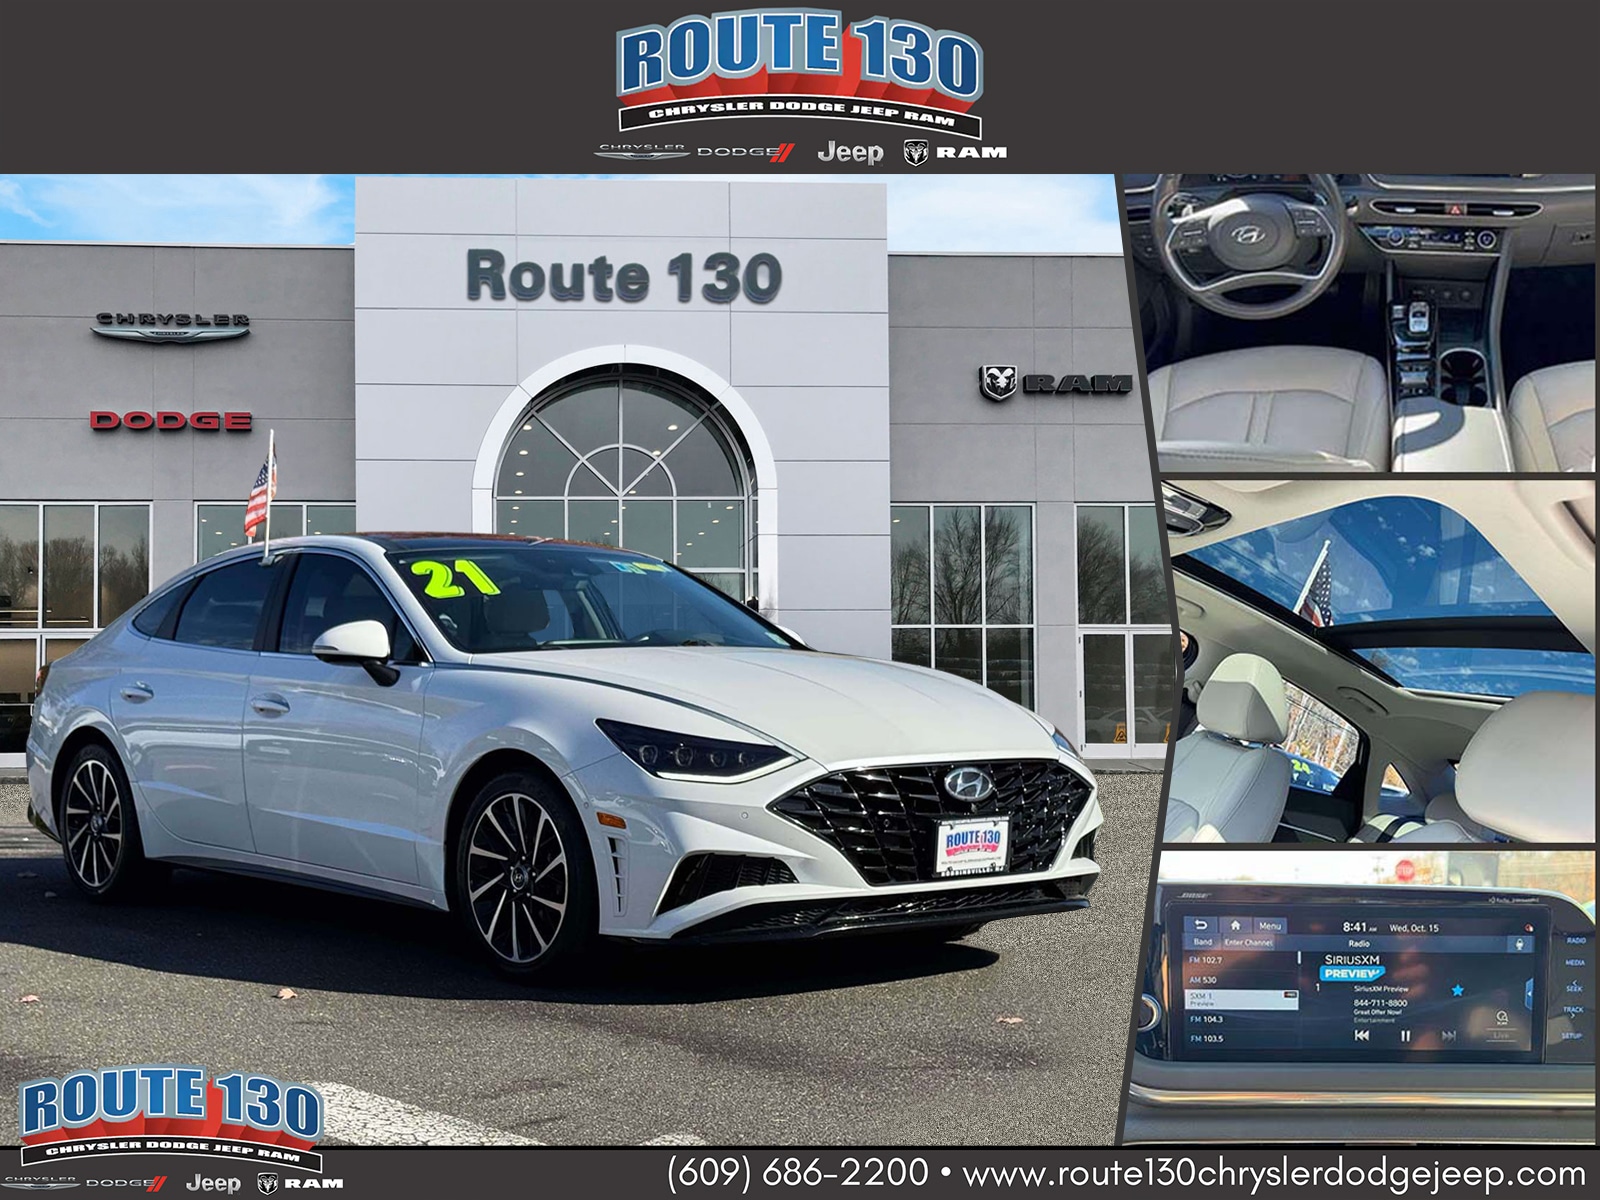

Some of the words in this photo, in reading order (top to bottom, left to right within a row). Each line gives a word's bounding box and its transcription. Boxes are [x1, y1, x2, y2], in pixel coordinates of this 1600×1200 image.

[467, 248, 650, 301] Route
[668, 252, 782, 303] 130
[96, 312, 250, 325] CHRYSLER
[1022, 374, 1133, 394] RAM
[89, 411, 252, 430] DODGE
[411, 559, 501, 599] 21
[946, 830, 980, 848] ROUTE
[983, 830, 1001, 845] 130
[1259, 922, 1282, 930] Menu
[1343, 922, 1367, 932] 8:41
[1411, 924, 1427, 932] Oct.
[1429, 924, 1439, 932] 15
[1194, 938, 1213, 946] Band
[1244, 938, 1273, 947] Channel
[1349, 940, 1370, 948] Radio
[1189, 956, 1200, 964] FM
[1202, 956, 1222, 964] 102.7
[1325, 955, 1380, 965] SIRIUSXM
[1325, 969, 1379, 978] PREVIEW
[1202, 976, 1217, 984] 530
[1383, 985, 1409, 993] Preview
